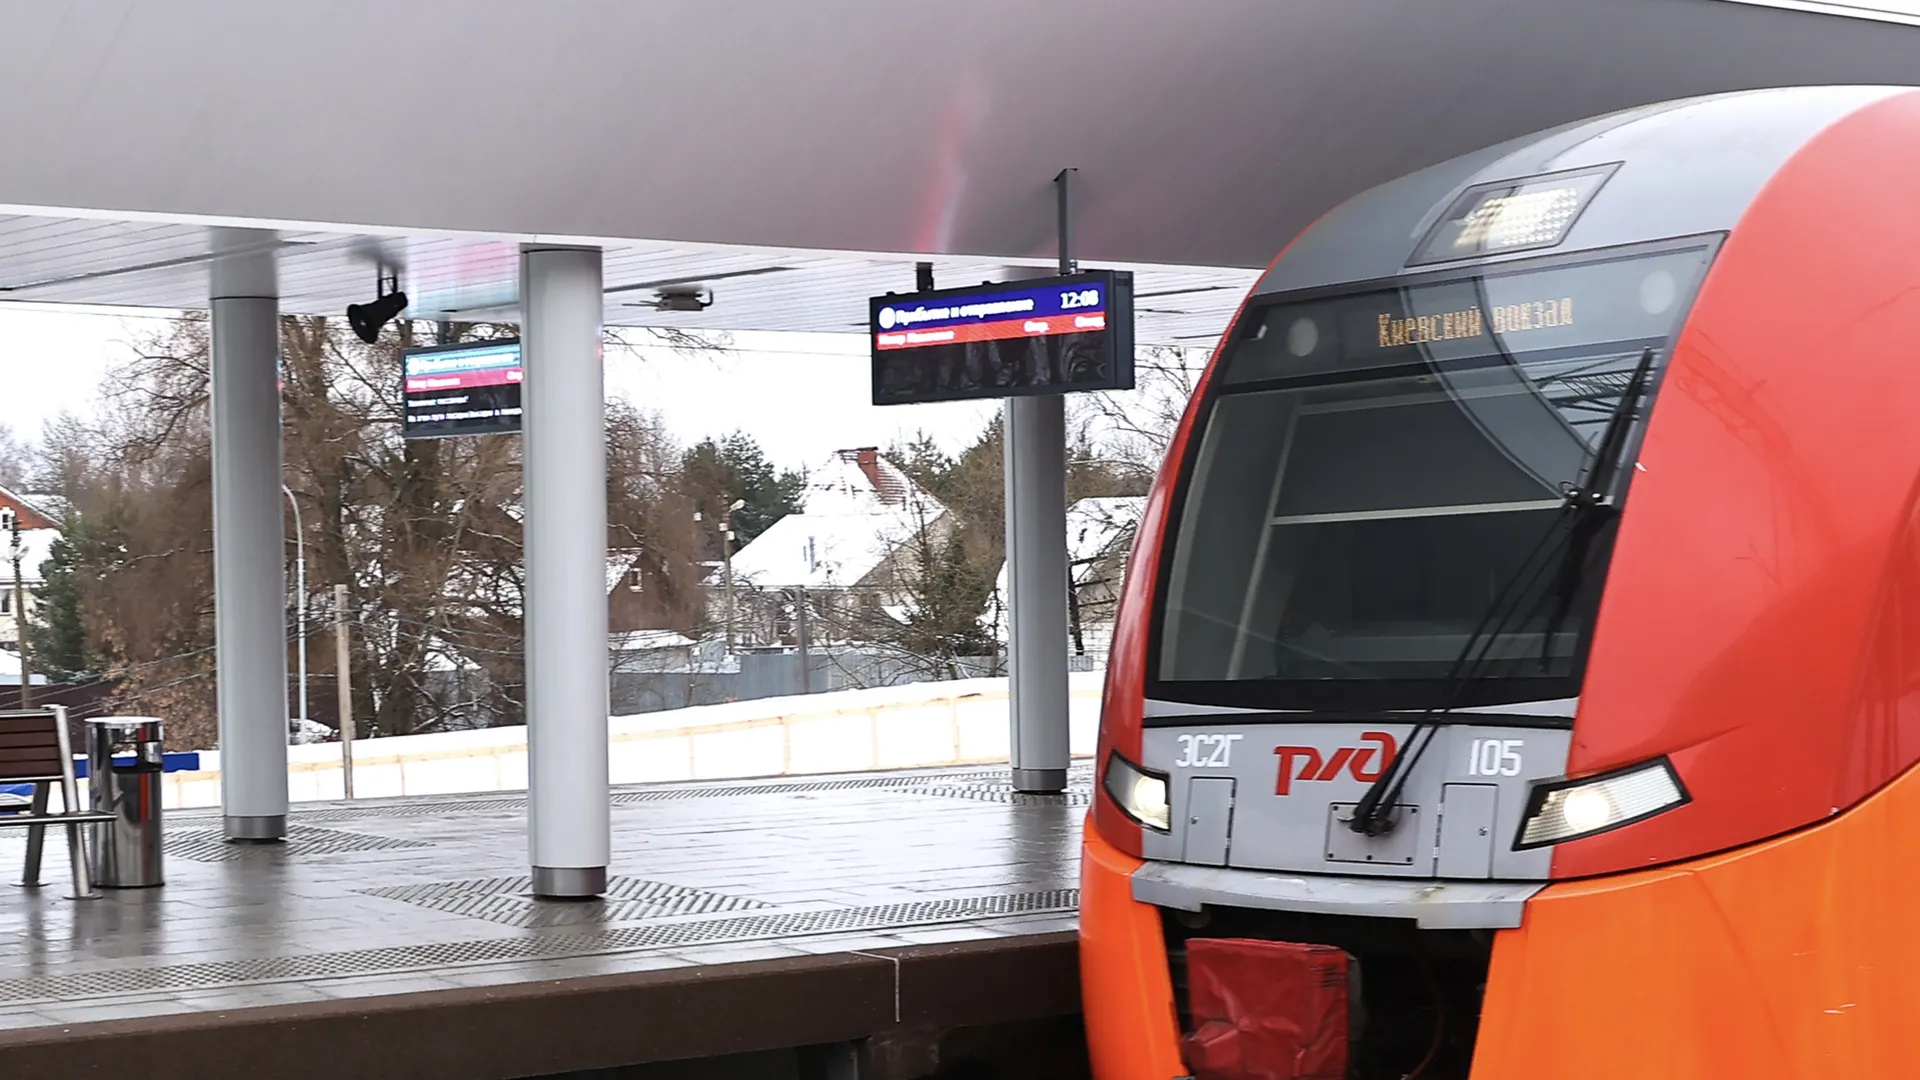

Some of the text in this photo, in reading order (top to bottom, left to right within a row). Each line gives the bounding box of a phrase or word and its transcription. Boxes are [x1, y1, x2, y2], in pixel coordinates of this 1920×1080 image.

[1377, 297, 1574, 348] Киевский вокзал
[1175, 733, 1243, 768] ЭС2Г
[1468, 738, 1525, 777] 105
